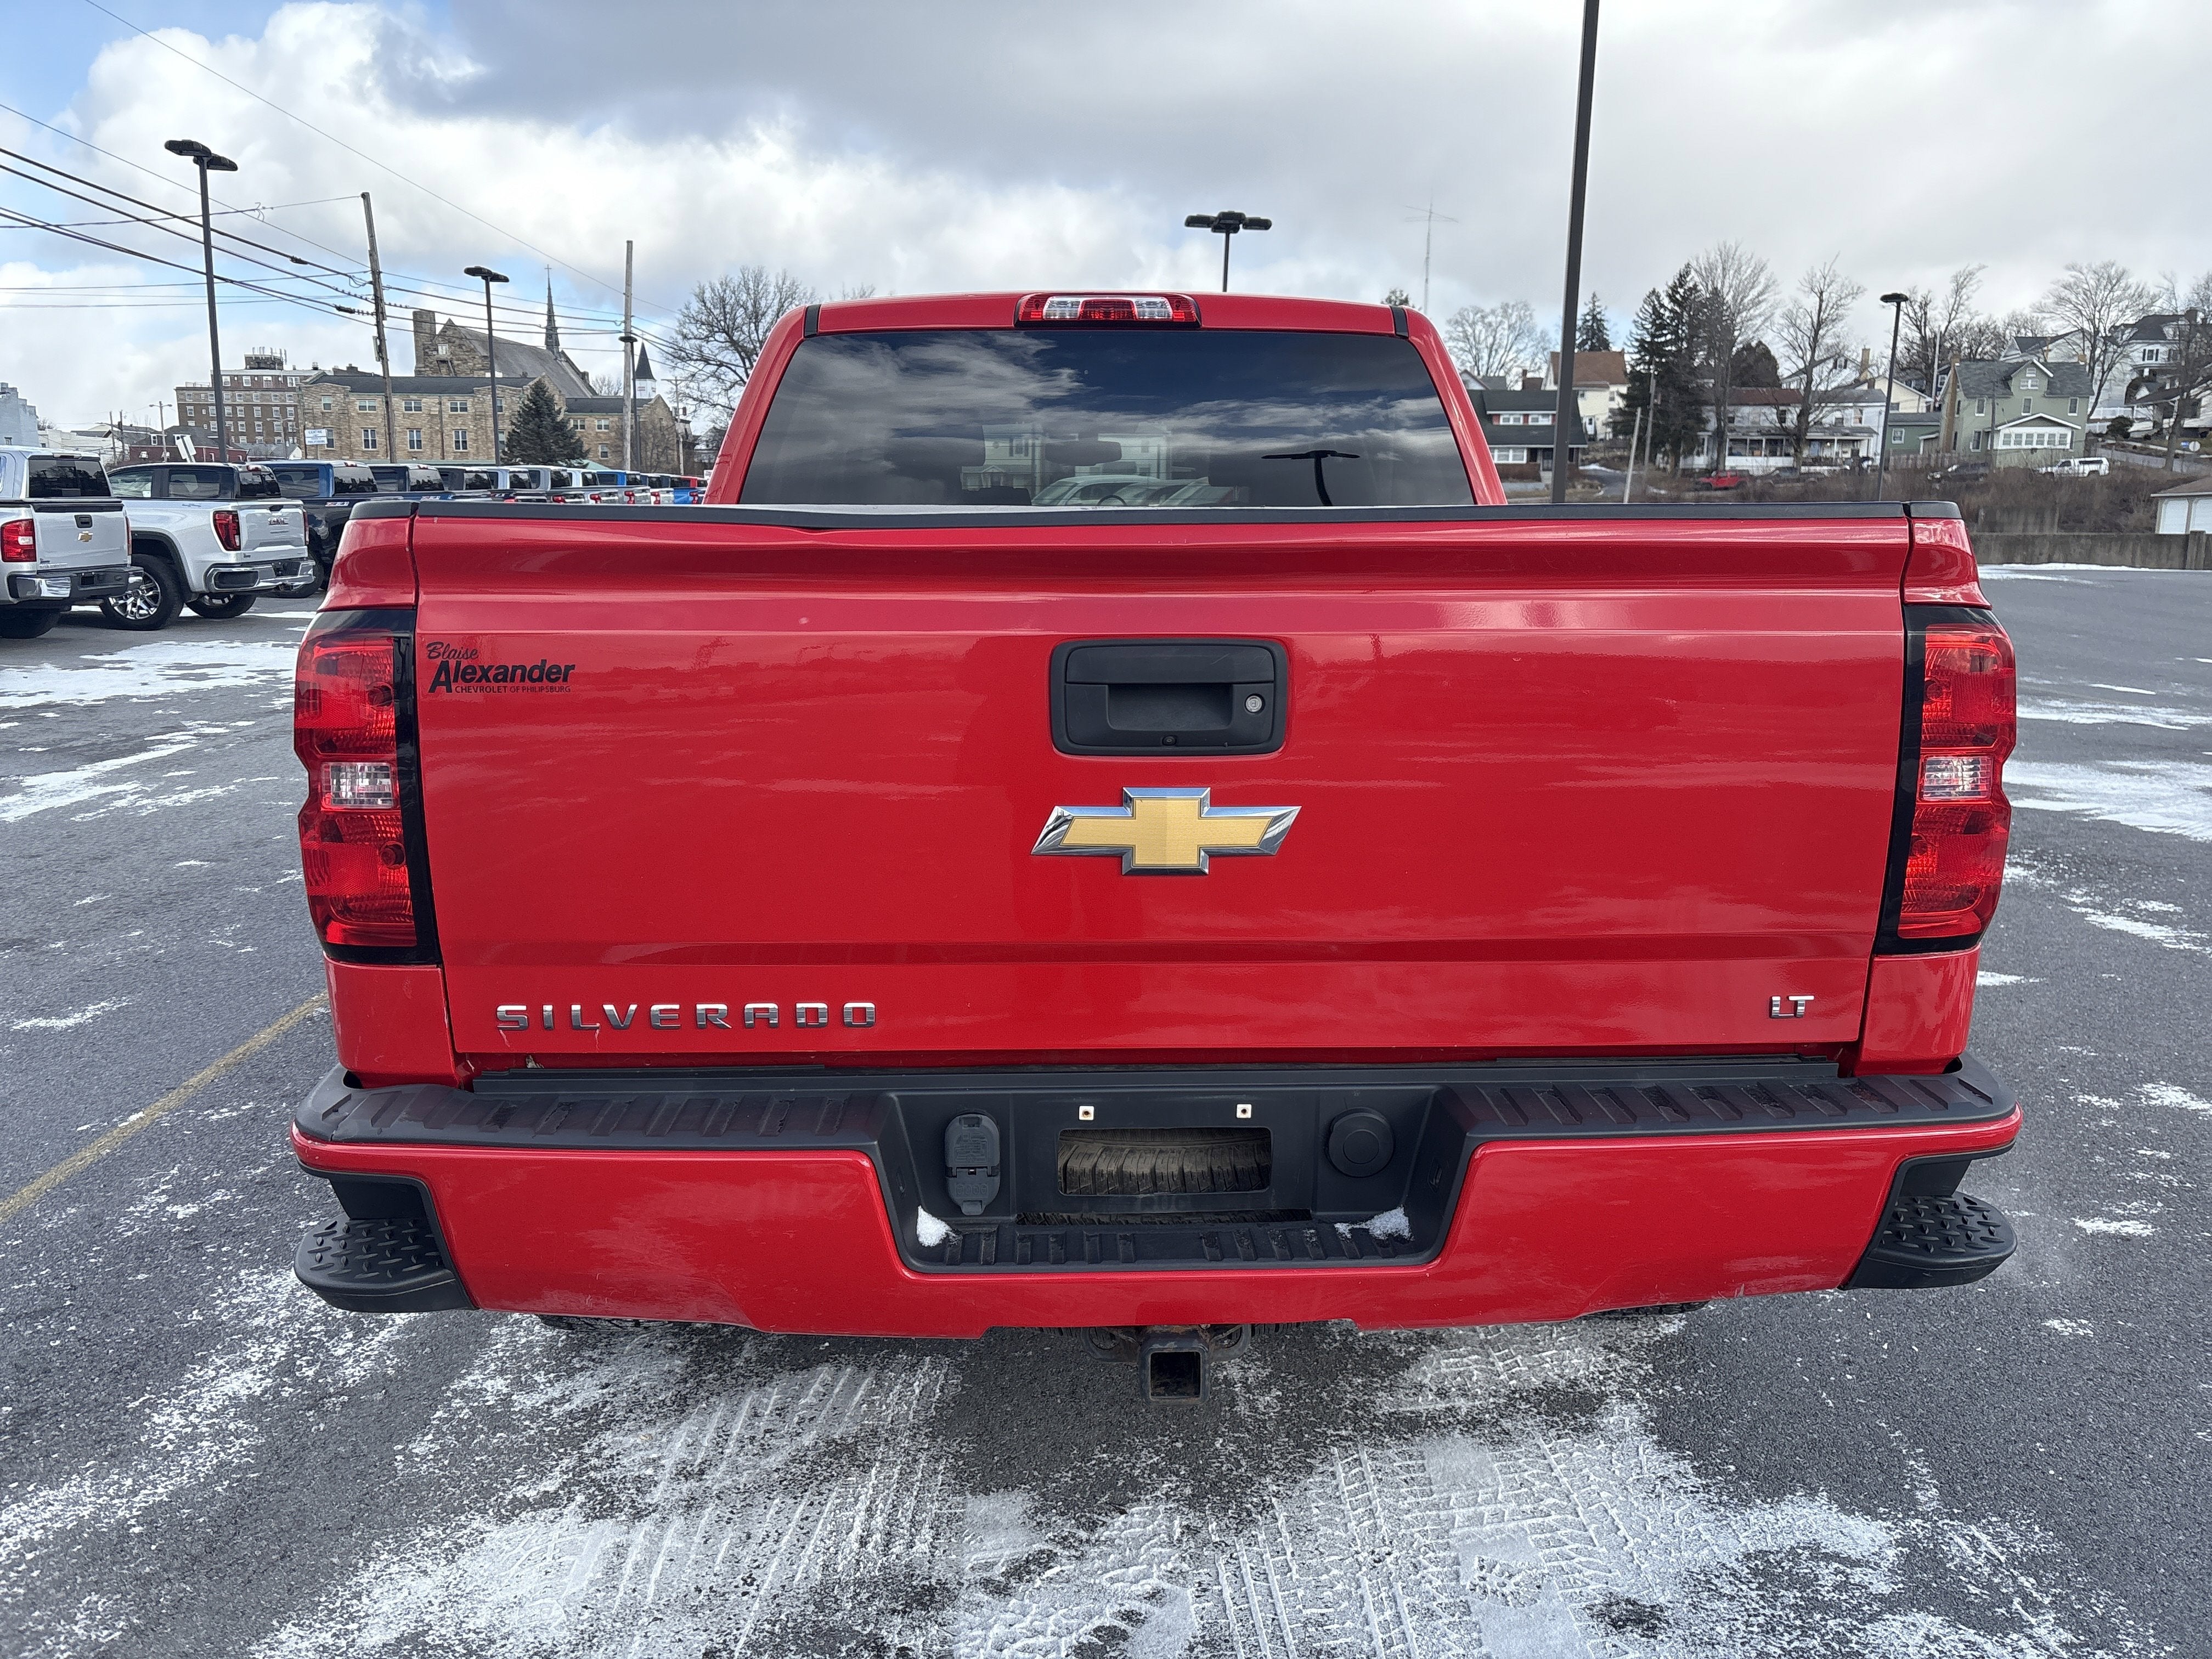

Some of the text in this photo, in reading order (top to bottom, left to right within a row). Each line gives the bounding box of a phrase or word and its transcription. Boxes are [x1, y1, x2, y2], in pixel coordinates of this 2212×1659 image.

[426, 641, 478, 659] Blaise
[428, 659, 575, 693] Alexander
[495, 1001, 876, 1031] SILVERADO
[1771, 995, 1815, 1018] LT
